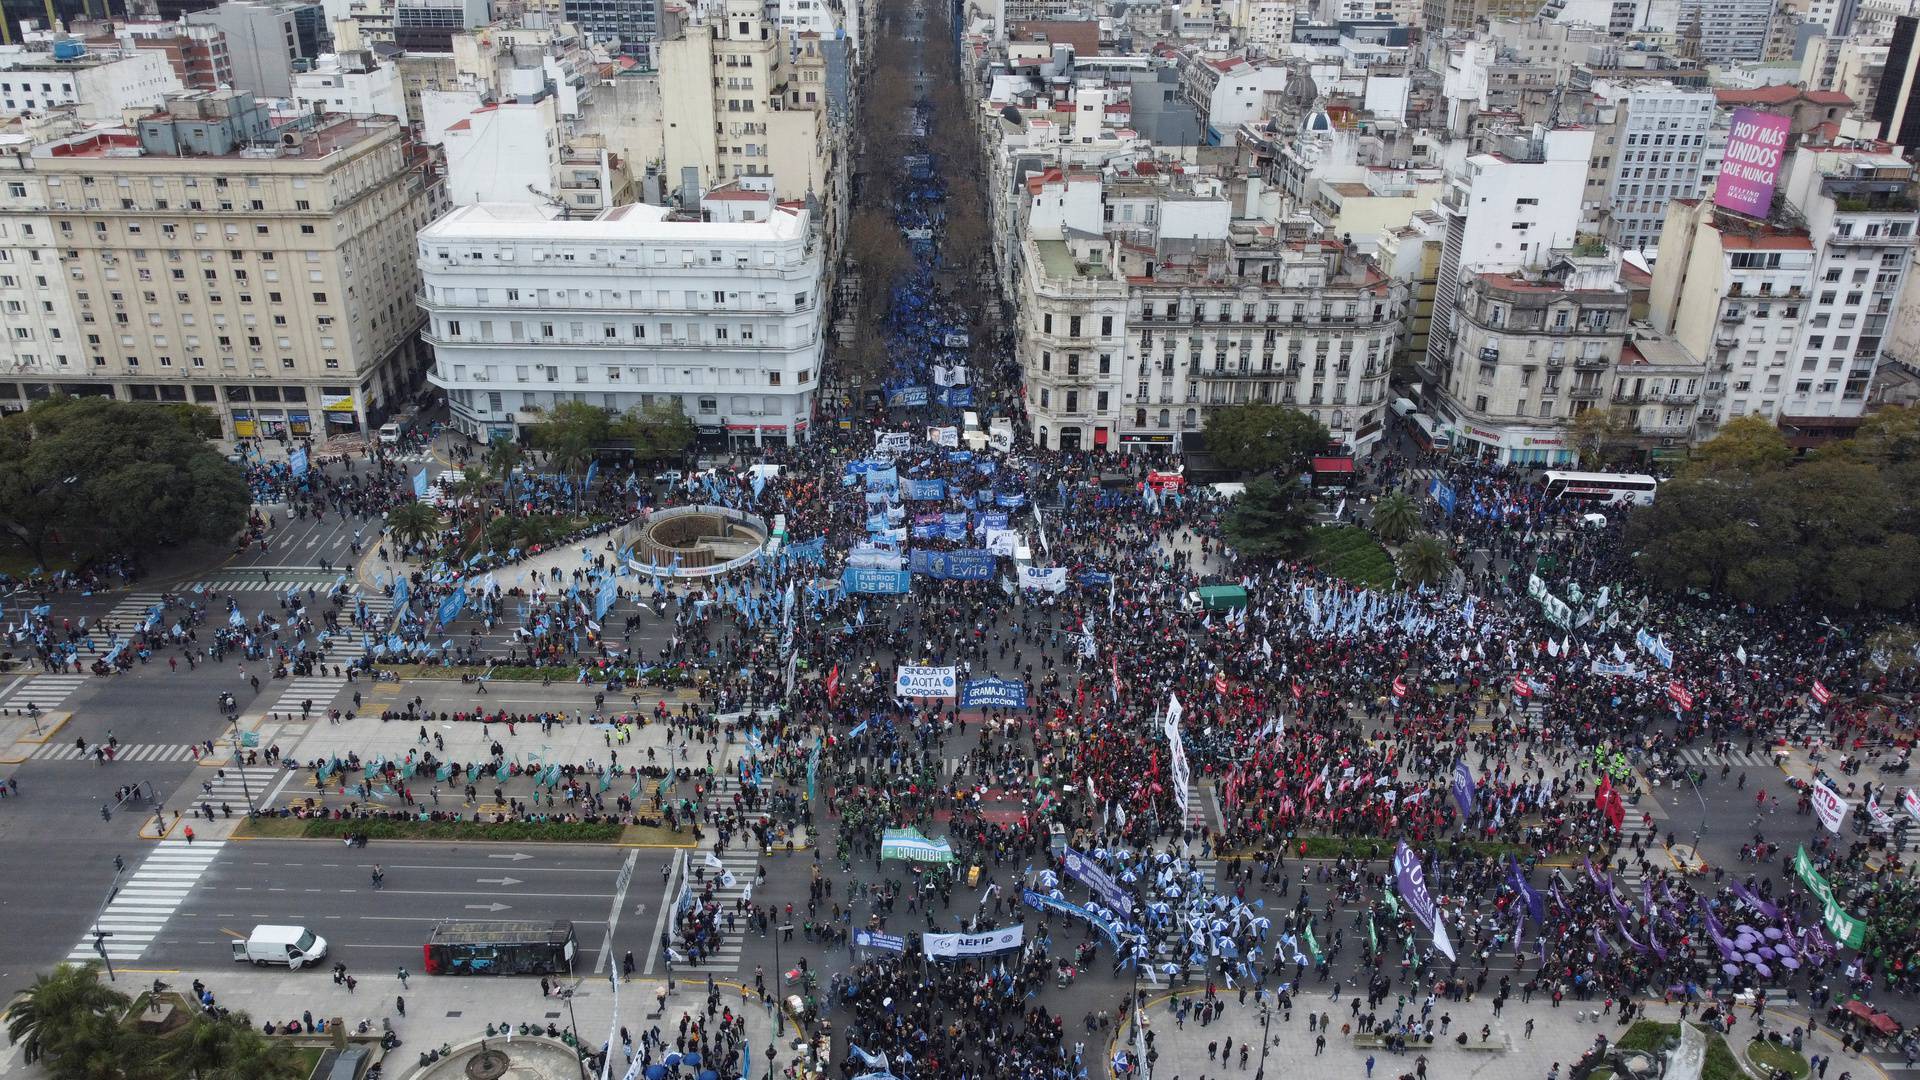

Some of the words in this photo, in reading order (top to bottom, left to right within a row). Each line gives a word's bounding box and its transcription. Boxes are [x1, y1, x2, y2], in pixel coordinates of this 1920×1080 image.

[1734, 121, 1759, 140] HOY
[1758, 126, 1786, 146] MÁS
[1727, 139, 1779, 168] UNIDOS
[1723, 161, 1741, 177] QUE
[1741, 165, 1774, 185] NUNCA
[1472, 428, 1501, 441] farmacity
[1532, 438, 1563, 446] farmacity
[1027, 568, 1053, 578] OLP
[859, 574, 896, 583] BARRIOS
[860, 583, 876, 591] DE
[878, 582, 895, 591] PIE
[904, 667, 950, 676] SINDICATO
[905, 688, 949, 696] CORDOBA
[969, 686, 1006, 697] GRAMAJO
[969, 697, 1017, 706] CONDUCCION
[1815, 786, 1837, 811] MTD
[957, 936, 994, 947] AEFIP
